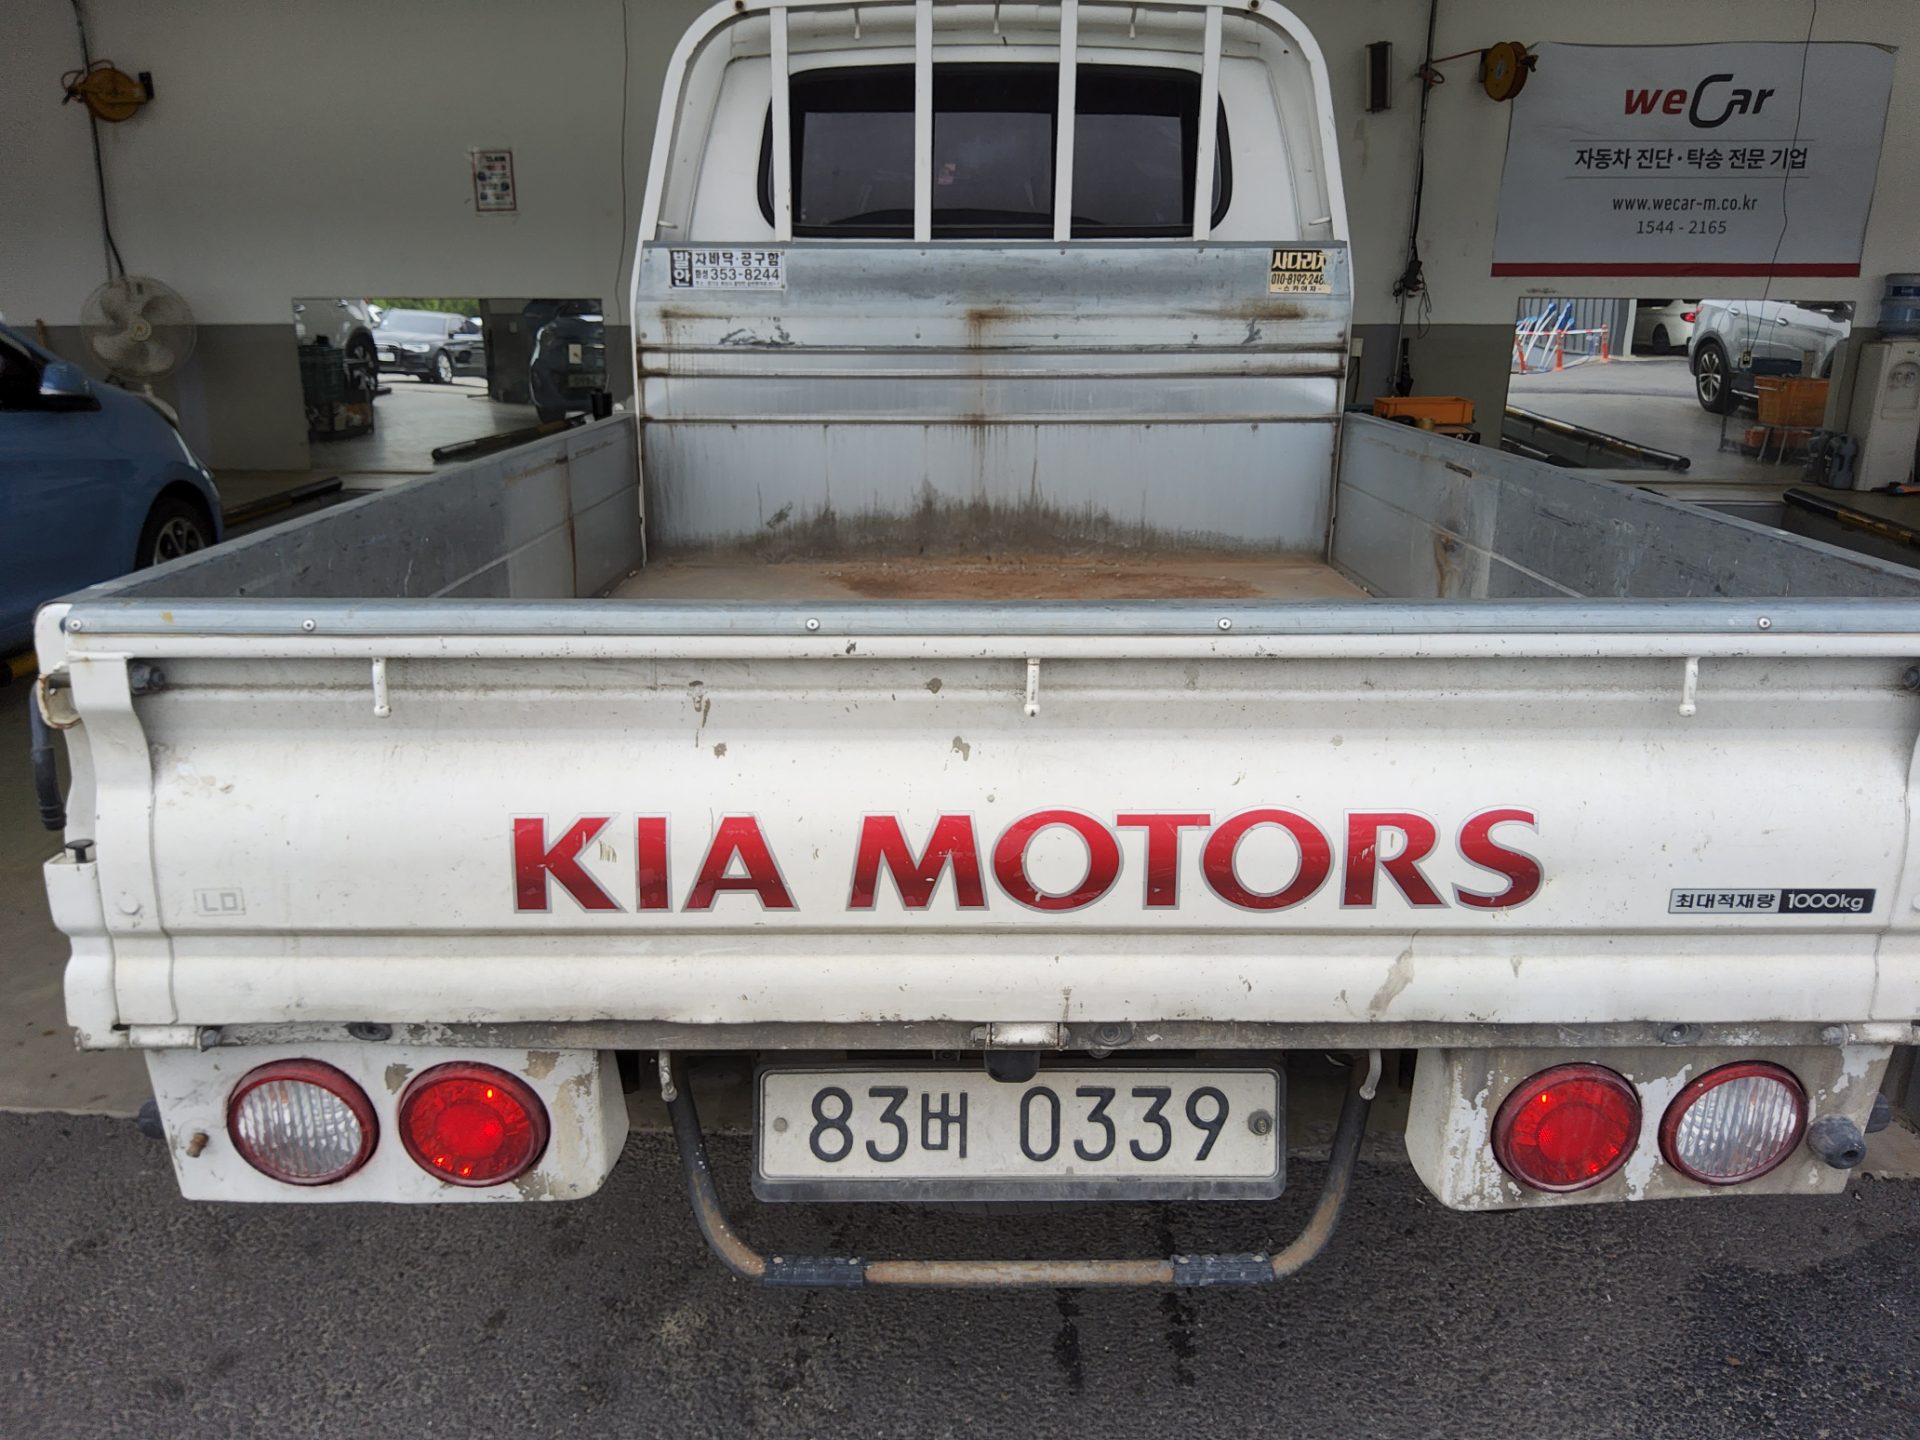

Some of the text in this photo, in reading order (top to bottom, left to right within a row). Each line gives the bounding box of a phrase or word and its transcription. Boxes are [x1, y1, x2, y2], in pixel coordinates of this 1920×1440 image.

[1624, 73, 1775, 128] weCar
[1574, 148, 1632, 170] 자동차
[1728, 147, 1766, 170] 전문
[1769, 147, 1808, 170] 기업
[1612, 194, 1758, 212] www.wecar-m.co.kr
[1636, 220, 1674, 235] 1544
[1689, 220, 1727, 235] 2165
[710, 268, 779, 281] 353-8244
[509, 805, 1544, 913] KIA MOTORS
[1675, 893, 1865, 911] 최대적재량 1000kg
[809, 1086, 1229, 1162] 83버 0339
